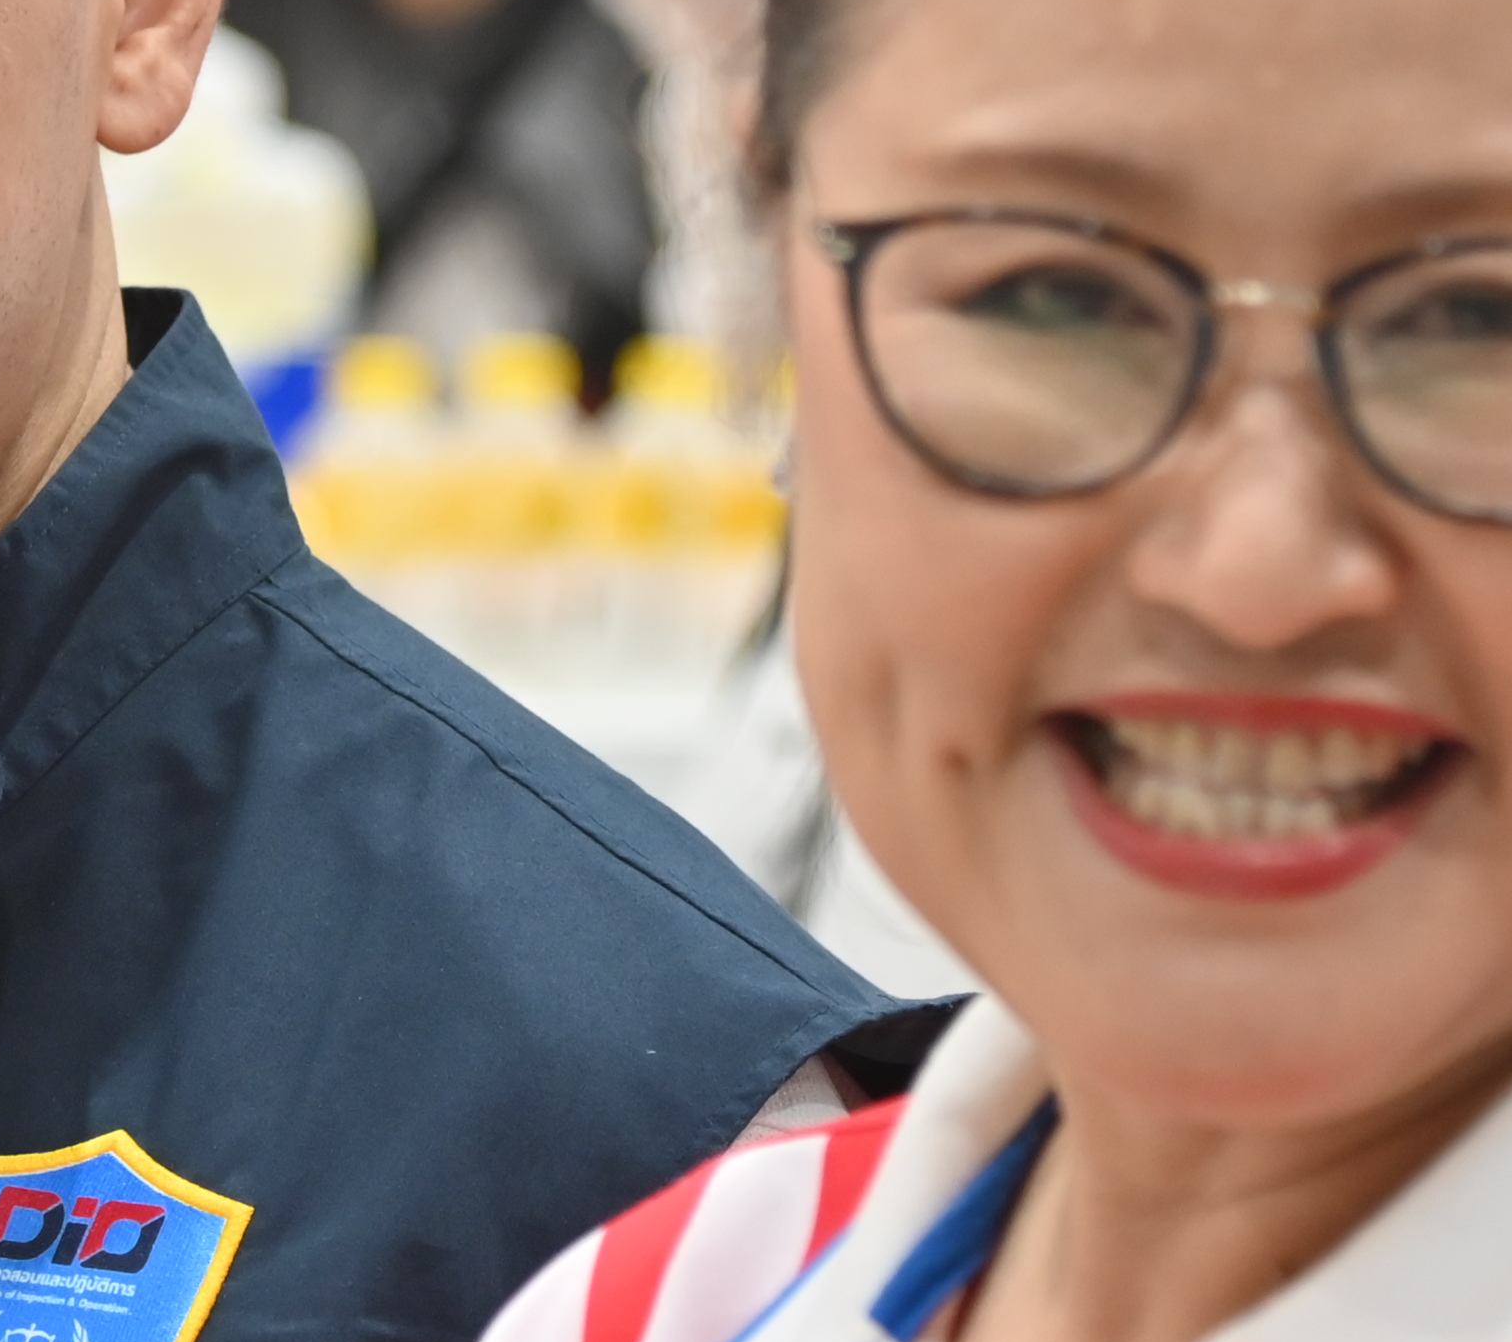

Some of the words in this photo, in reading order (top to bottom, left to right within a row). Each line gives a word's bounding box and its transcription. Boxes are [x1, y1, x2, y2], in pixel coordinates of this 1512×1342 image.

[4, 1289, 17, 1300] of
[17, 1290, 66, 1306] Inspection
[67, 1296, 76, 1307] &
